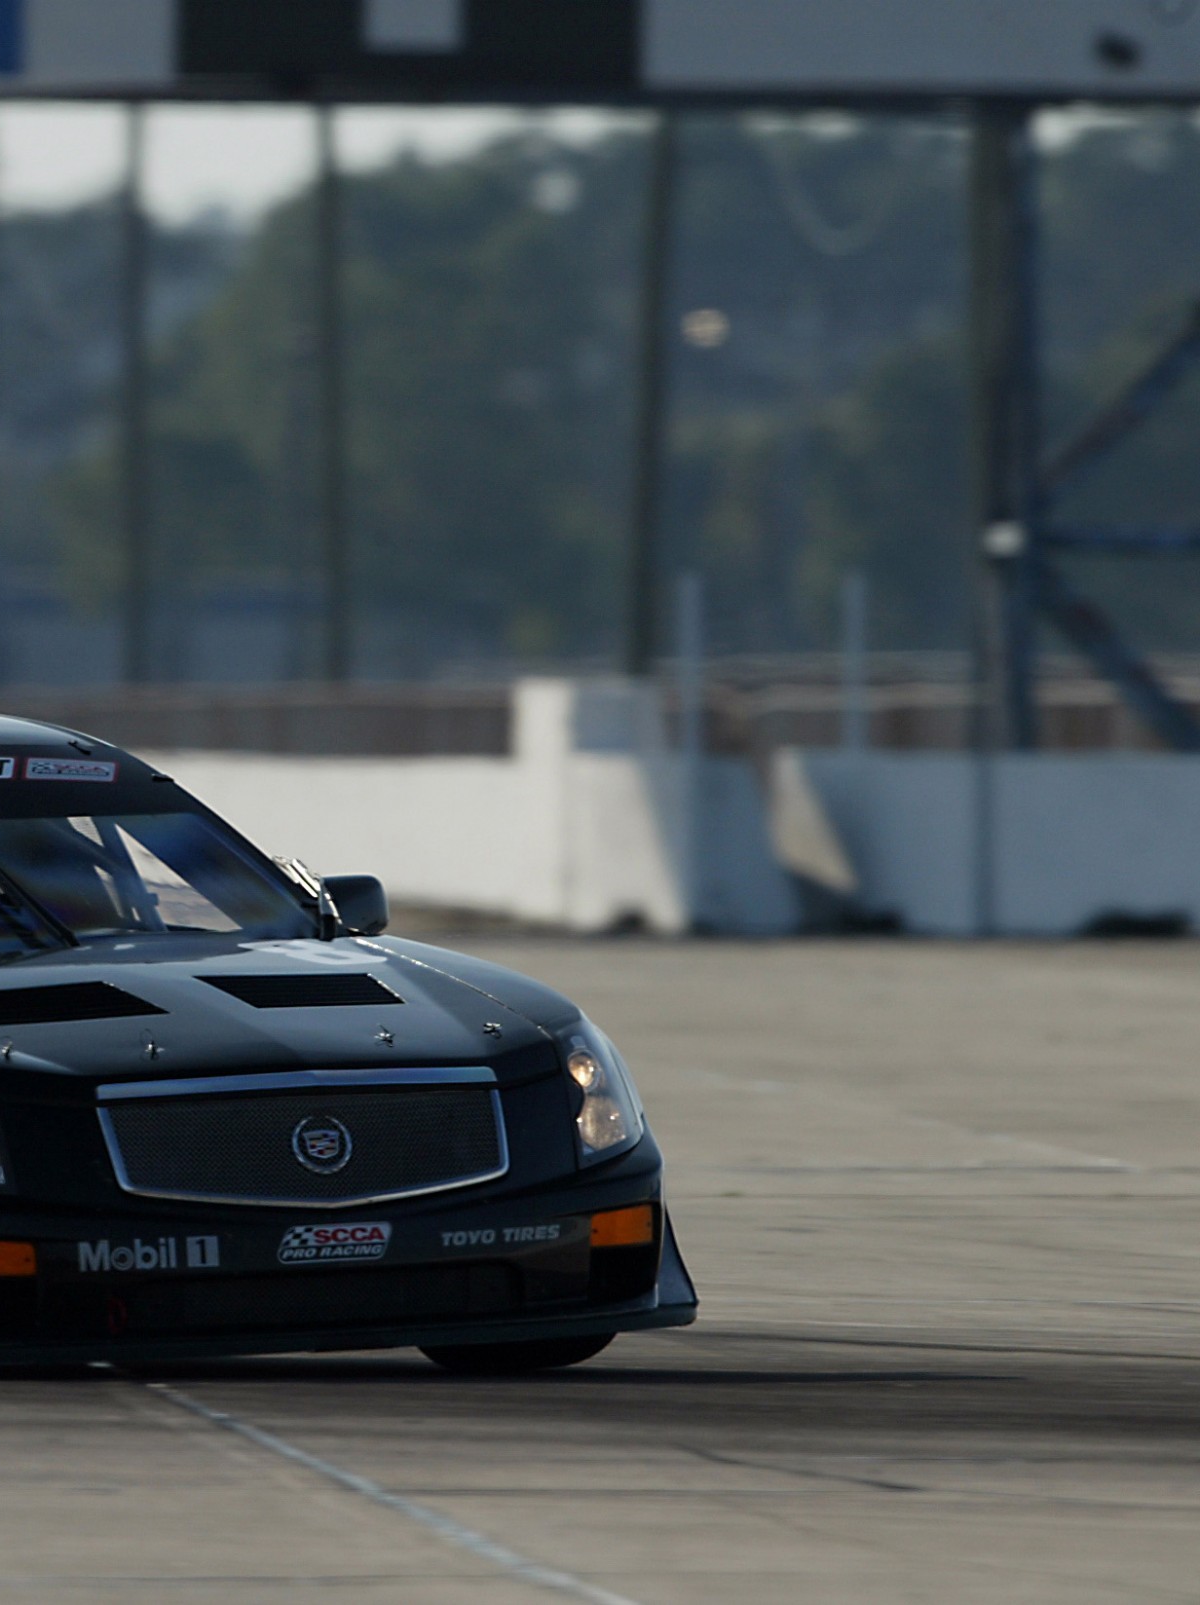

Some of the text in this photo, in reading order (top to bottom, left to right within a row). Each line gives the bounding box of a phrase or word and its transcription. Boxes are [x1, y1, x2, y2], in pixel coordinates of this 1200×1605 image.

[313, 1226, 384, 1244] SCCA
[442, 1224, 560, 1247] TOYO TIRES
[78, 1236, 177, 1272] Mobil
[282, 1244, 383, 1260] PRO RACING
